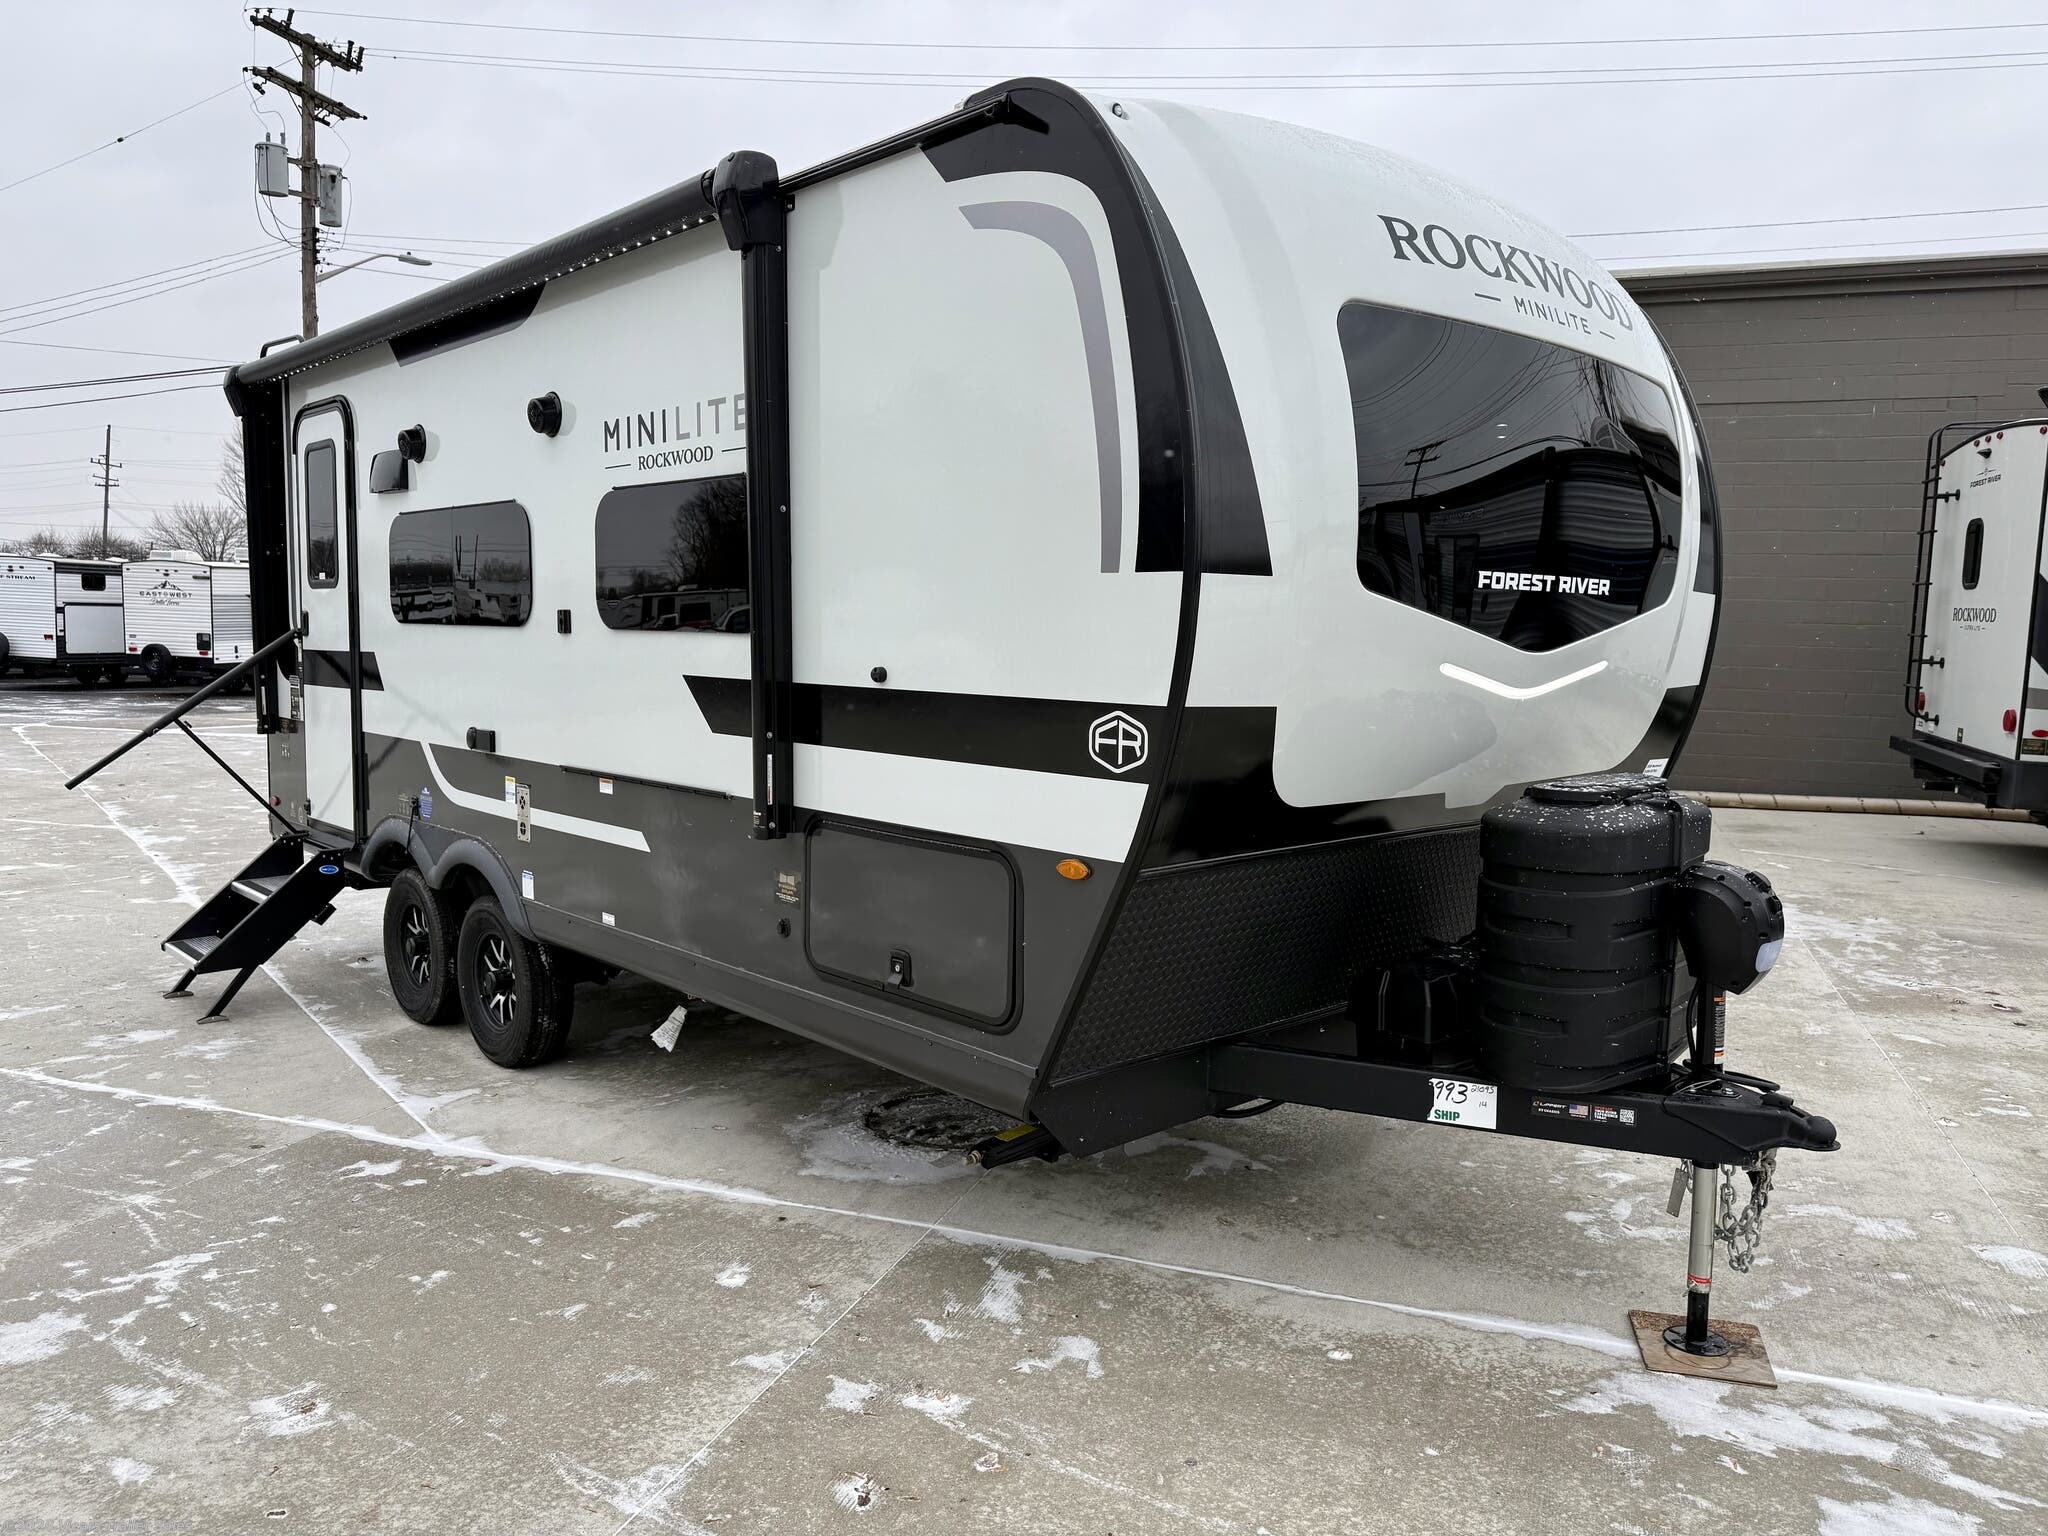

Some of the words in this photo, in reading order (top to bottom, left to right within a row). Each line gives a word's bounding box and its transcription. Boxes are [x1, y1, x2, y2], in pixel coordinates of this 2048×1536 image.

[1377, 214, 1633, 331] ROCKWOOD
[1513, 295, 1592, 335] MINILITE
[603, 393, 746, 453] MINILITE
[638, 445, 714, 470] ROCKWOOD
[1478, 570, 1556, 592] FOREST
[1558, 576, 1610, 596] RIVER
[1952, 607, 1997, 623] ROCKWOOD
[1434, 1109, 1461, 1121] SHIP
